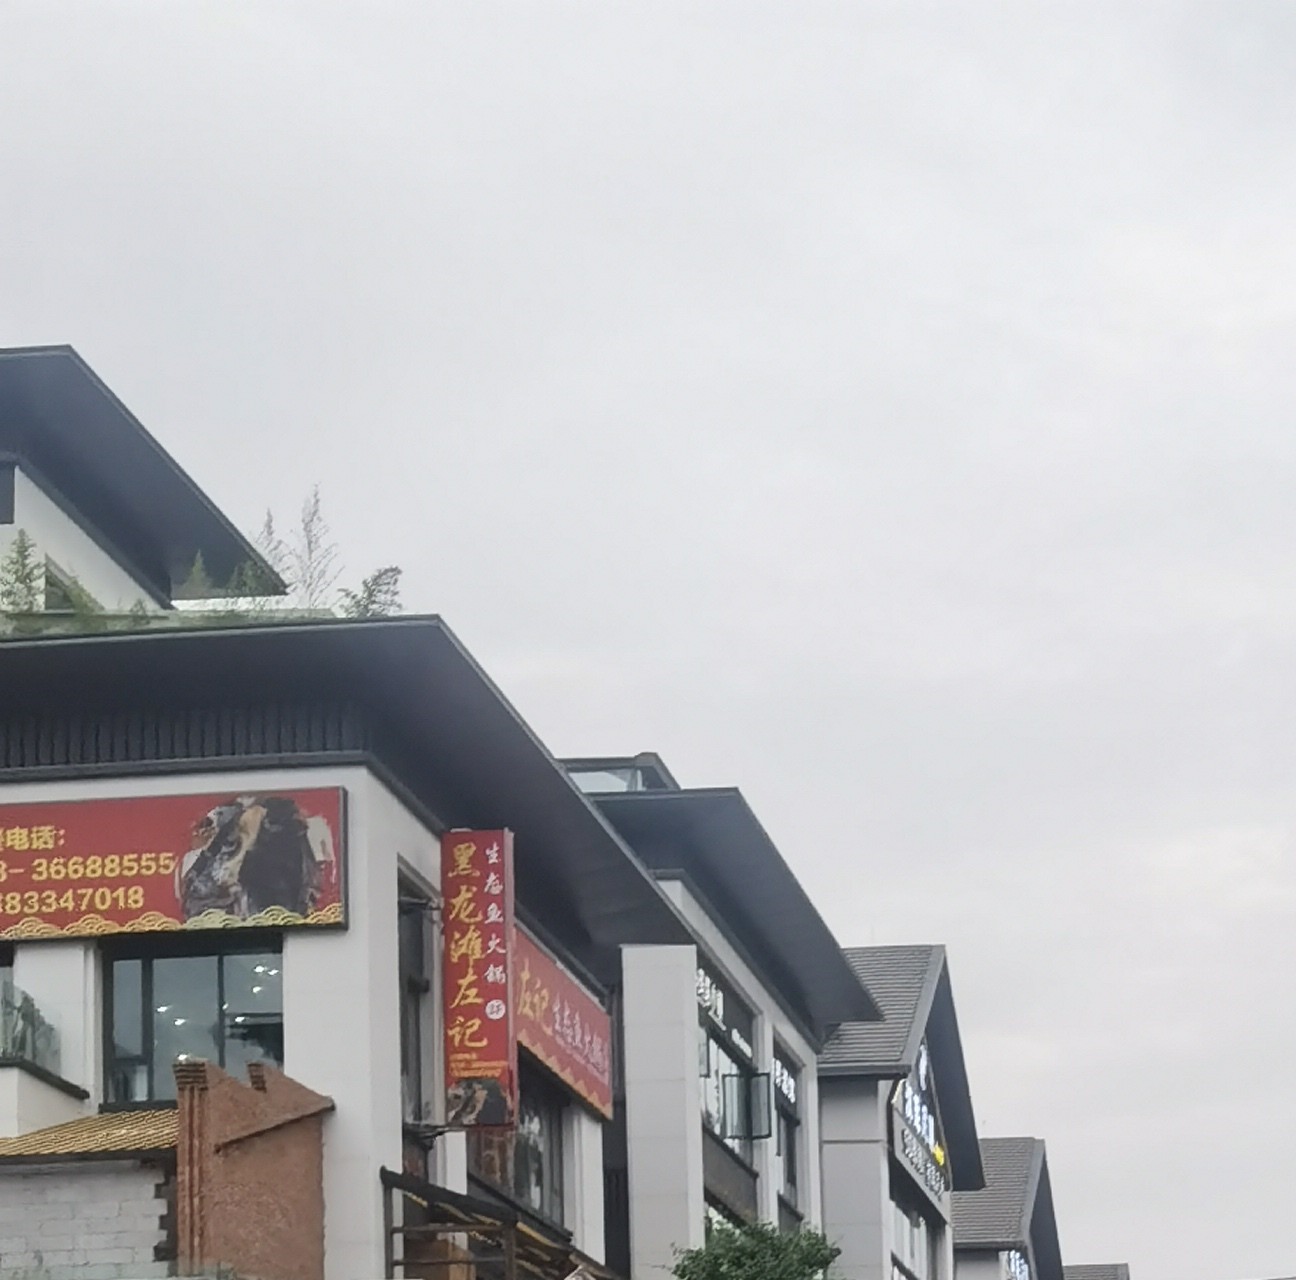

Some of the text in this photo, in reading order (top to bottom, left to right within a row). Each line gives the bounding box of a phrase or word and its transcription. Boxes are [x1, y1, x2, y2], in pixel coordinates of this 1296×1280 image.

[0, 885, 144, 915] 83347018
[447, 842, 487, 1048] 黑龙滩左记
[484, 842, 507, 984] 生态鱼火锅
[517, 957, 553, 1036] 左记
